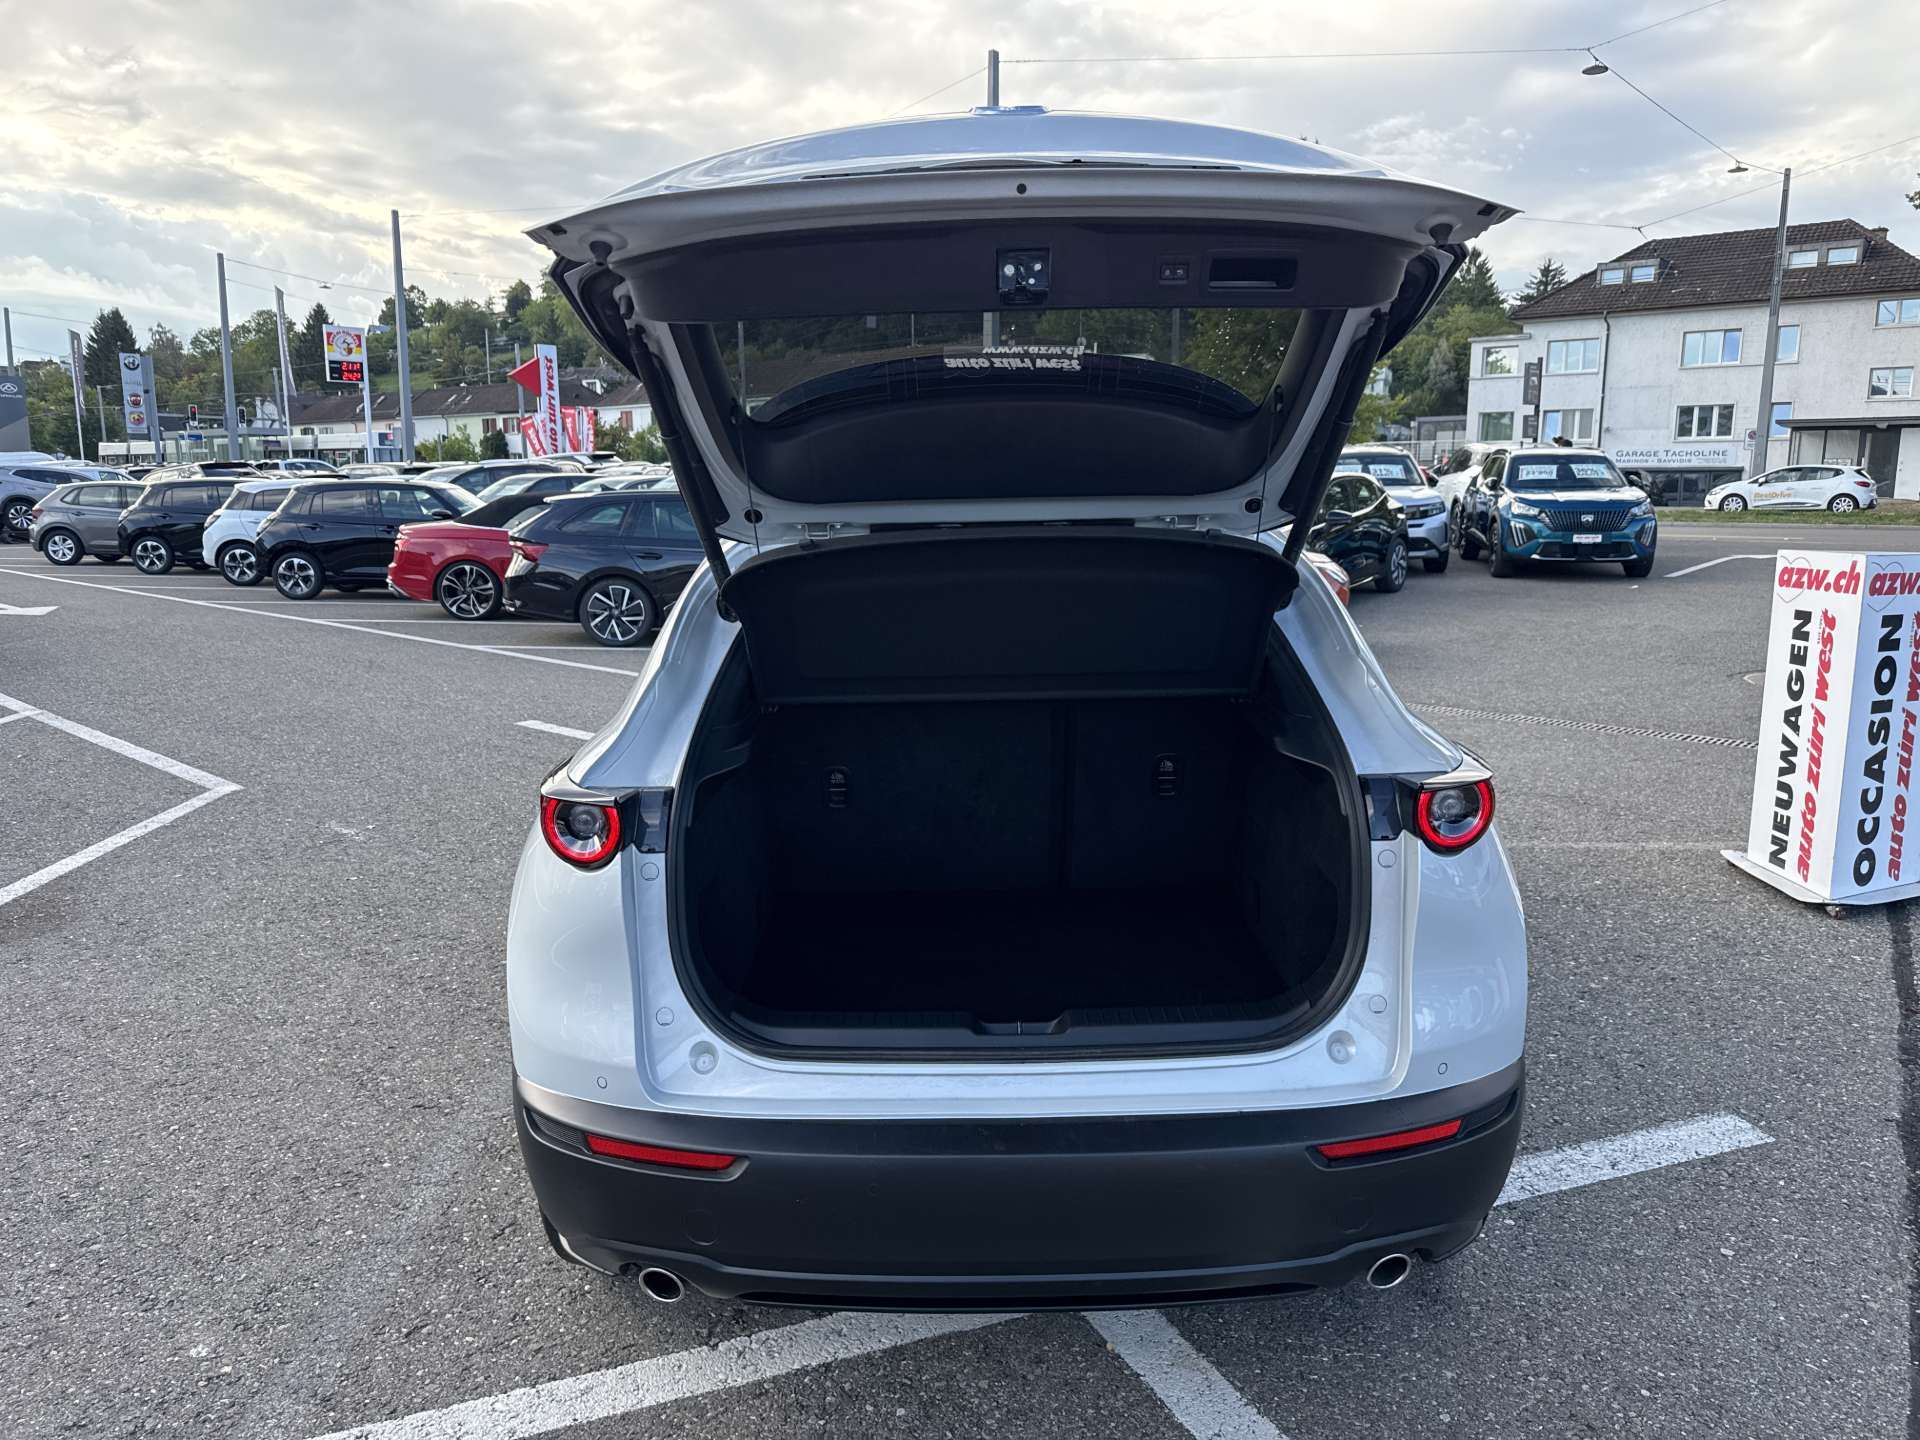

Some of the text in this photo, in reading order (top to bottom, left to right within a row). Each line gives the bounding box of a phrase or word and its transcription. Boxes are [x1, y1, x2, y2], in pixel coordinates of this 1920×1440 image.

[544, 356, 555, 391] west
[1615, 449, 1728, 458] GARAGE TACHOLINE
[1778, 560, 1861, 595] azw.ch
[1768, 609, 1812, 870] NEUWAGEN
[1797, 608, 1837, 883] auto züri west
[1853, 614, 1904, 887] OCCASION
[1896, 707, 1917, 793] züri
[1887, 794, 1907, 882] auto
